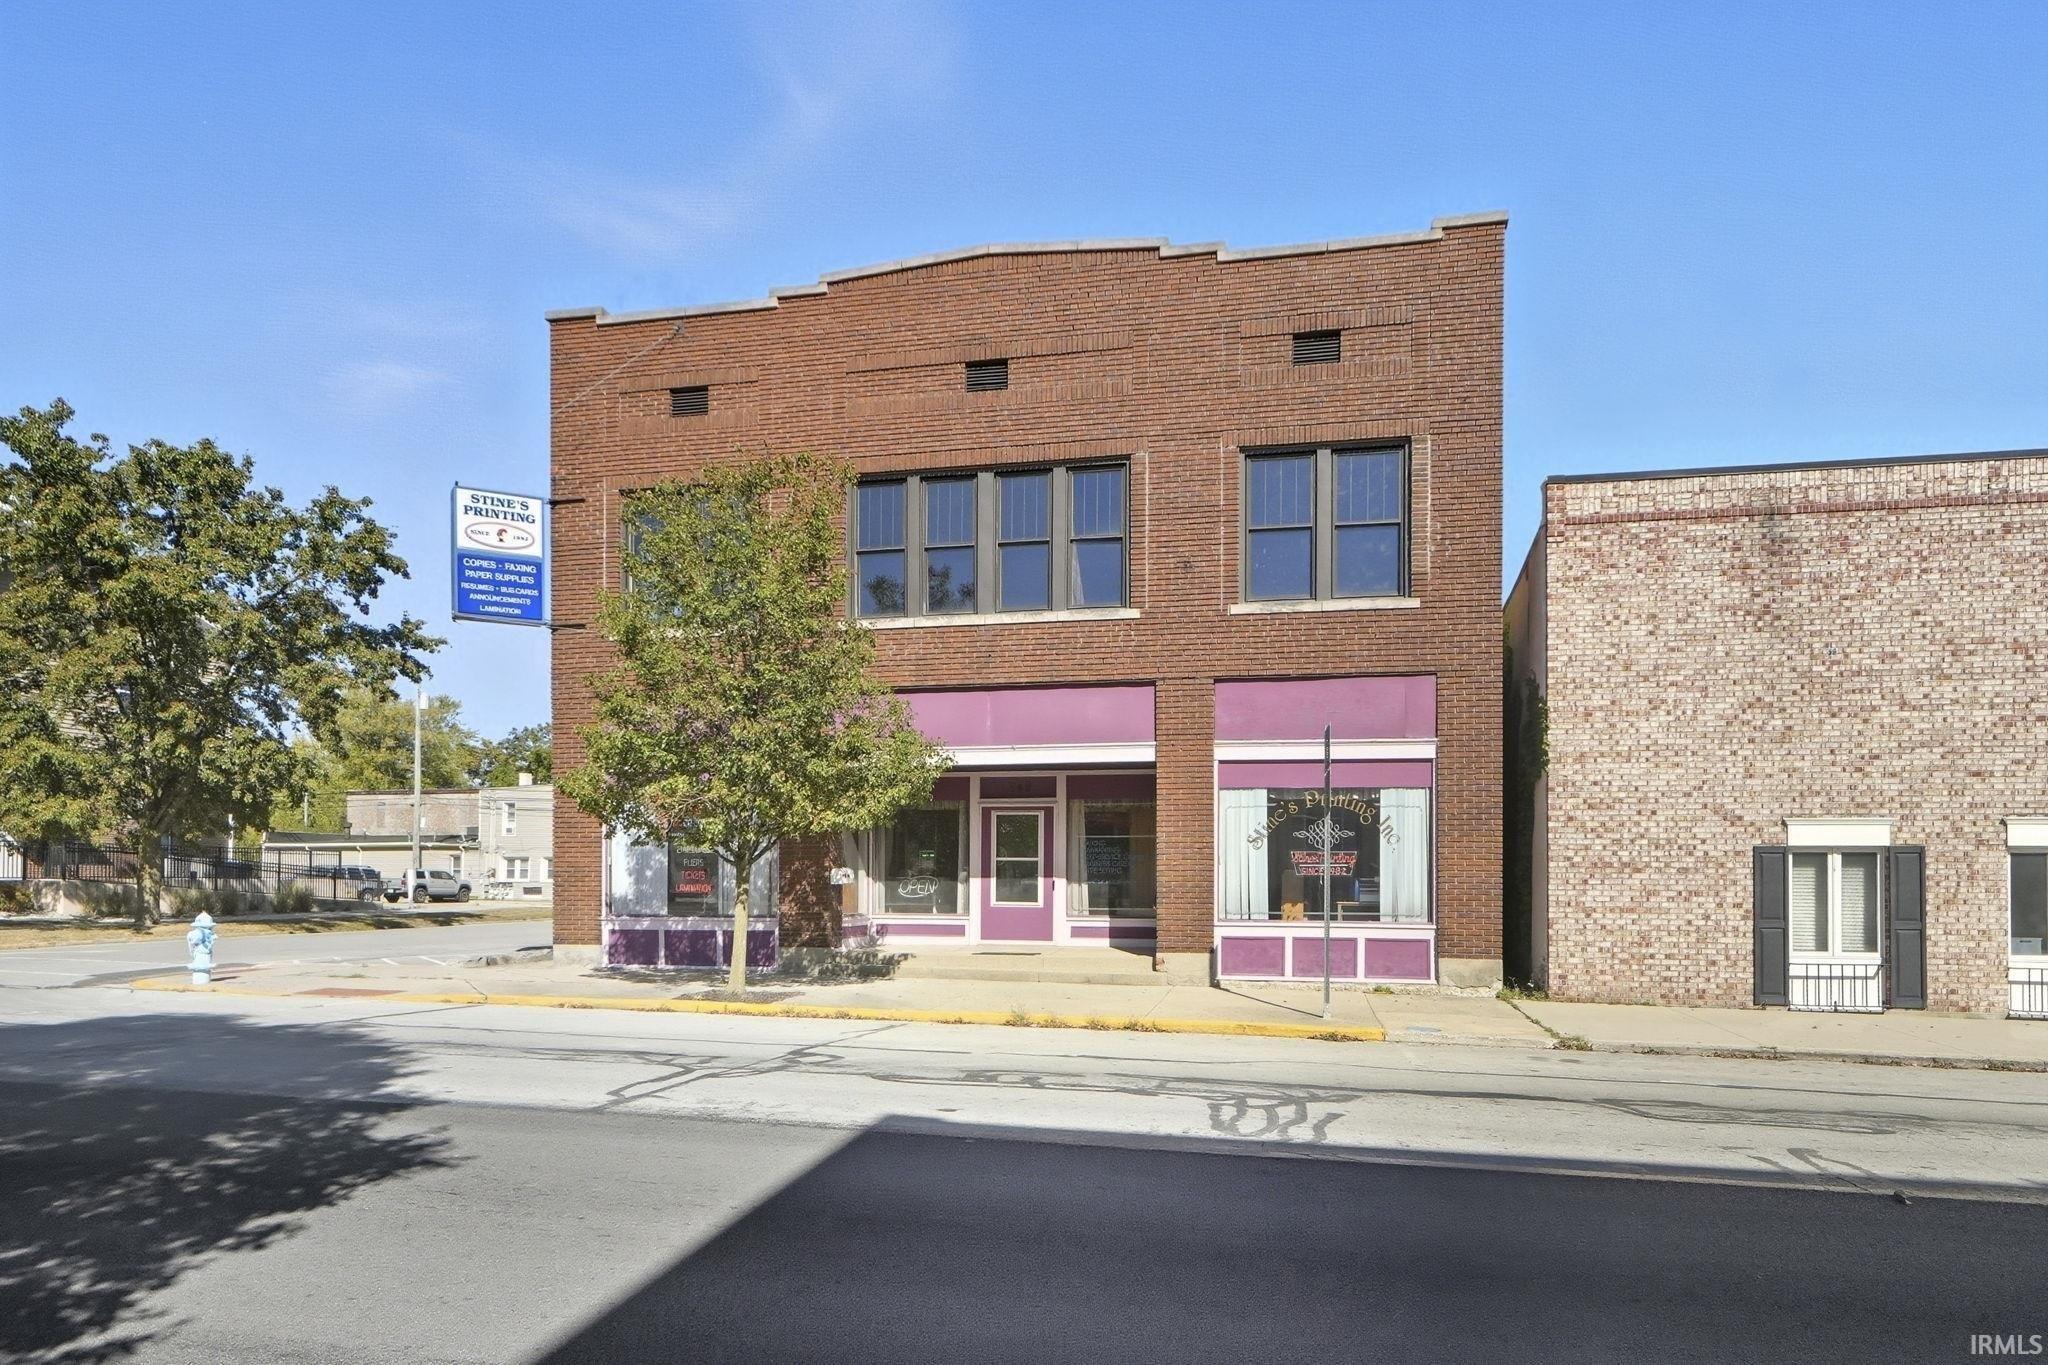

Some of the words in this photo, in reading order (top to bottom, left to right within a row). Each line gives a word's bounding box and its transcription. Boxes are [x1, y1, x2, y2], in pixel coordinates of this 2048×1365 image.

[471, 493, 529, 511] STINE'S
[464, 505, 535, 524] PRINTING
[463, 558, 496, 569] COPIES
[505, 562, 537, 574] FAXING
[465, 570, 493, 580] PAPER
[495, 573, 534, 584] SUPPLIES
[515, 588, 539, 597] CARDS
[480, 605, 521, 615] LAMINATION
[899, 879, 936, 894] OPEN
